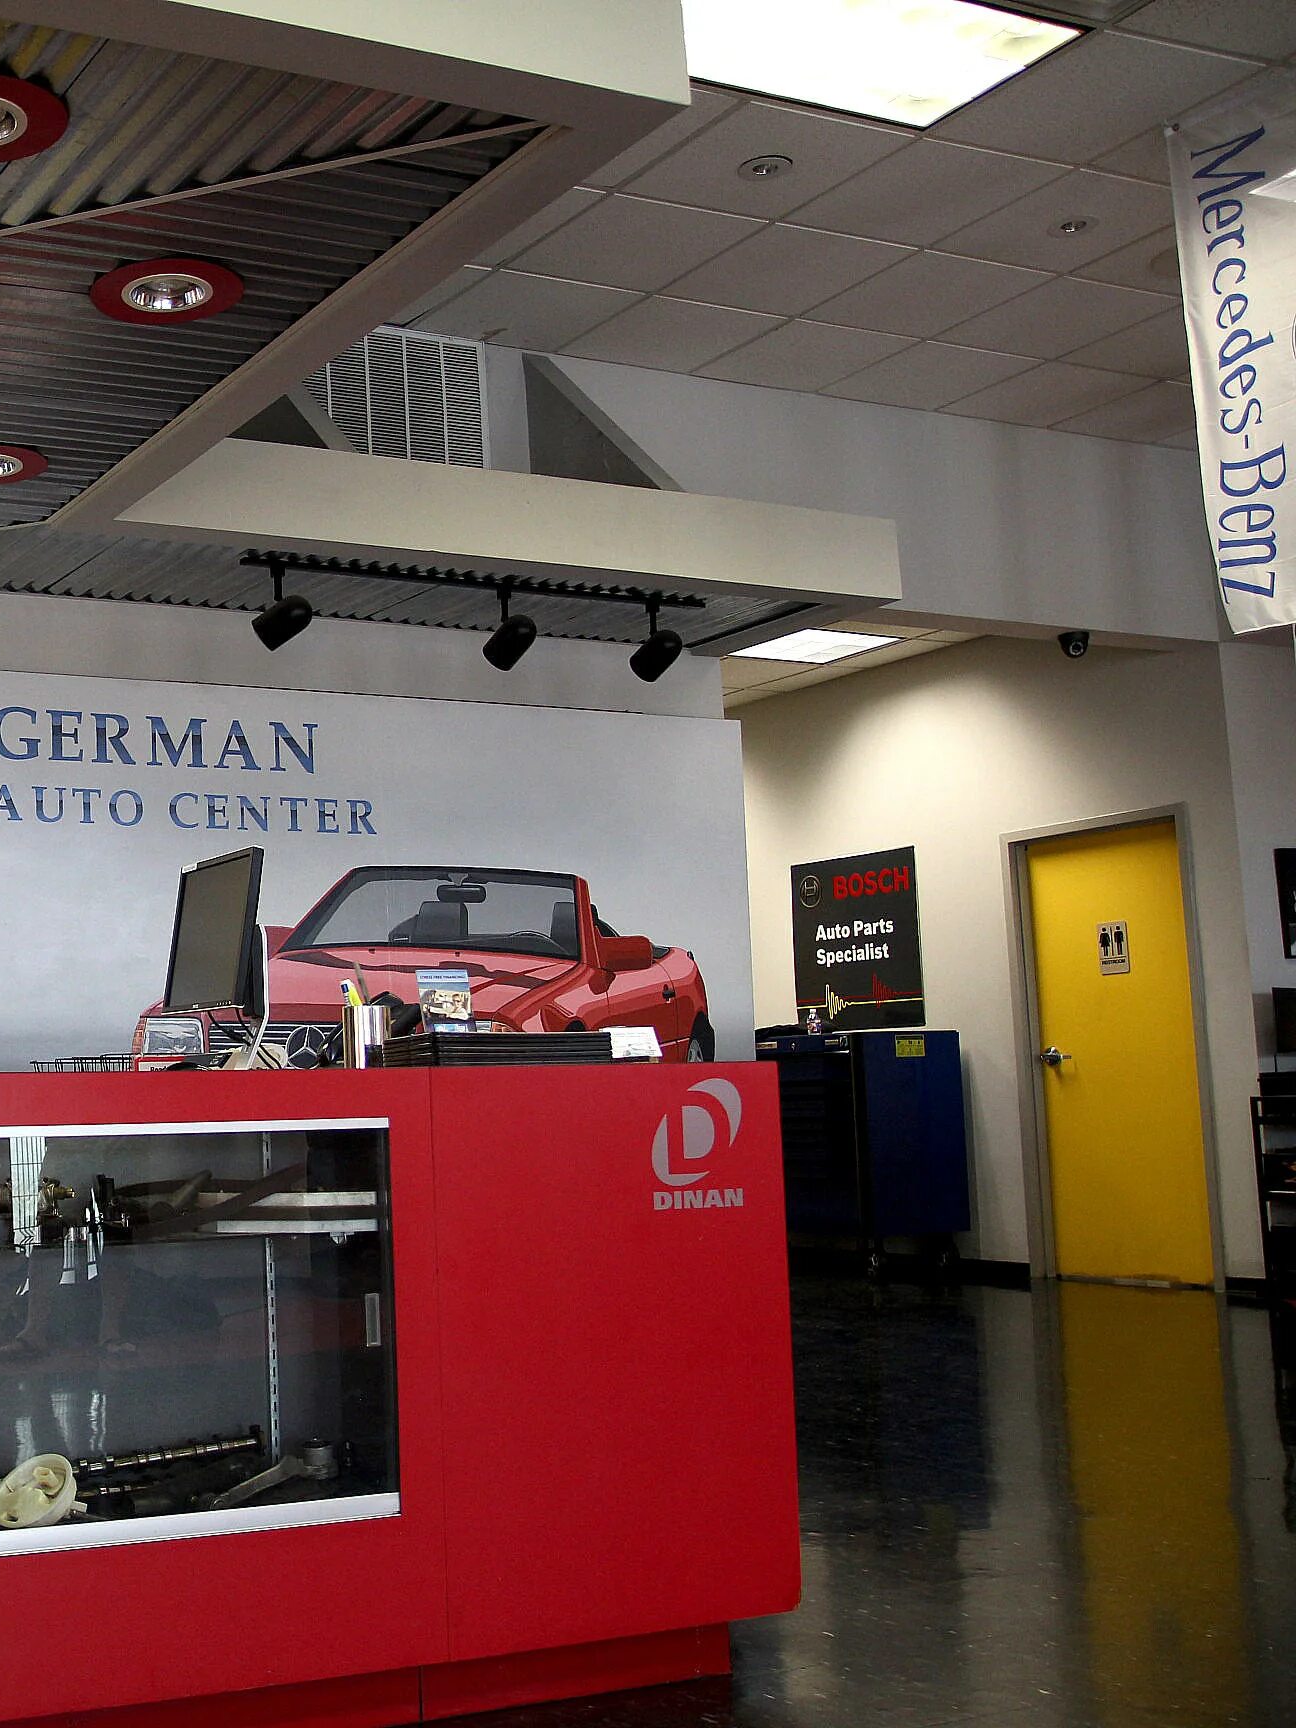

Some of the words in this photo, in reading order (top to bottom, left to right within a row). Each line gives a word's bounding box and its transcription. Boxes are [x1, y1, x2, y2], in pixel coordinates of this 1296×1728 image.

[1190, 125, 1286, 605] Mercedes-Benz
[169, 792, 378, 835] CENTER
[832, 865, 910, 900] BOSCH
[815, 923, 851, 942] Auto
[853, 918, 894, 937] Parts
[816, 942, 890, 967] Specialist
[653, 1187, 744, 1211] DINAN
